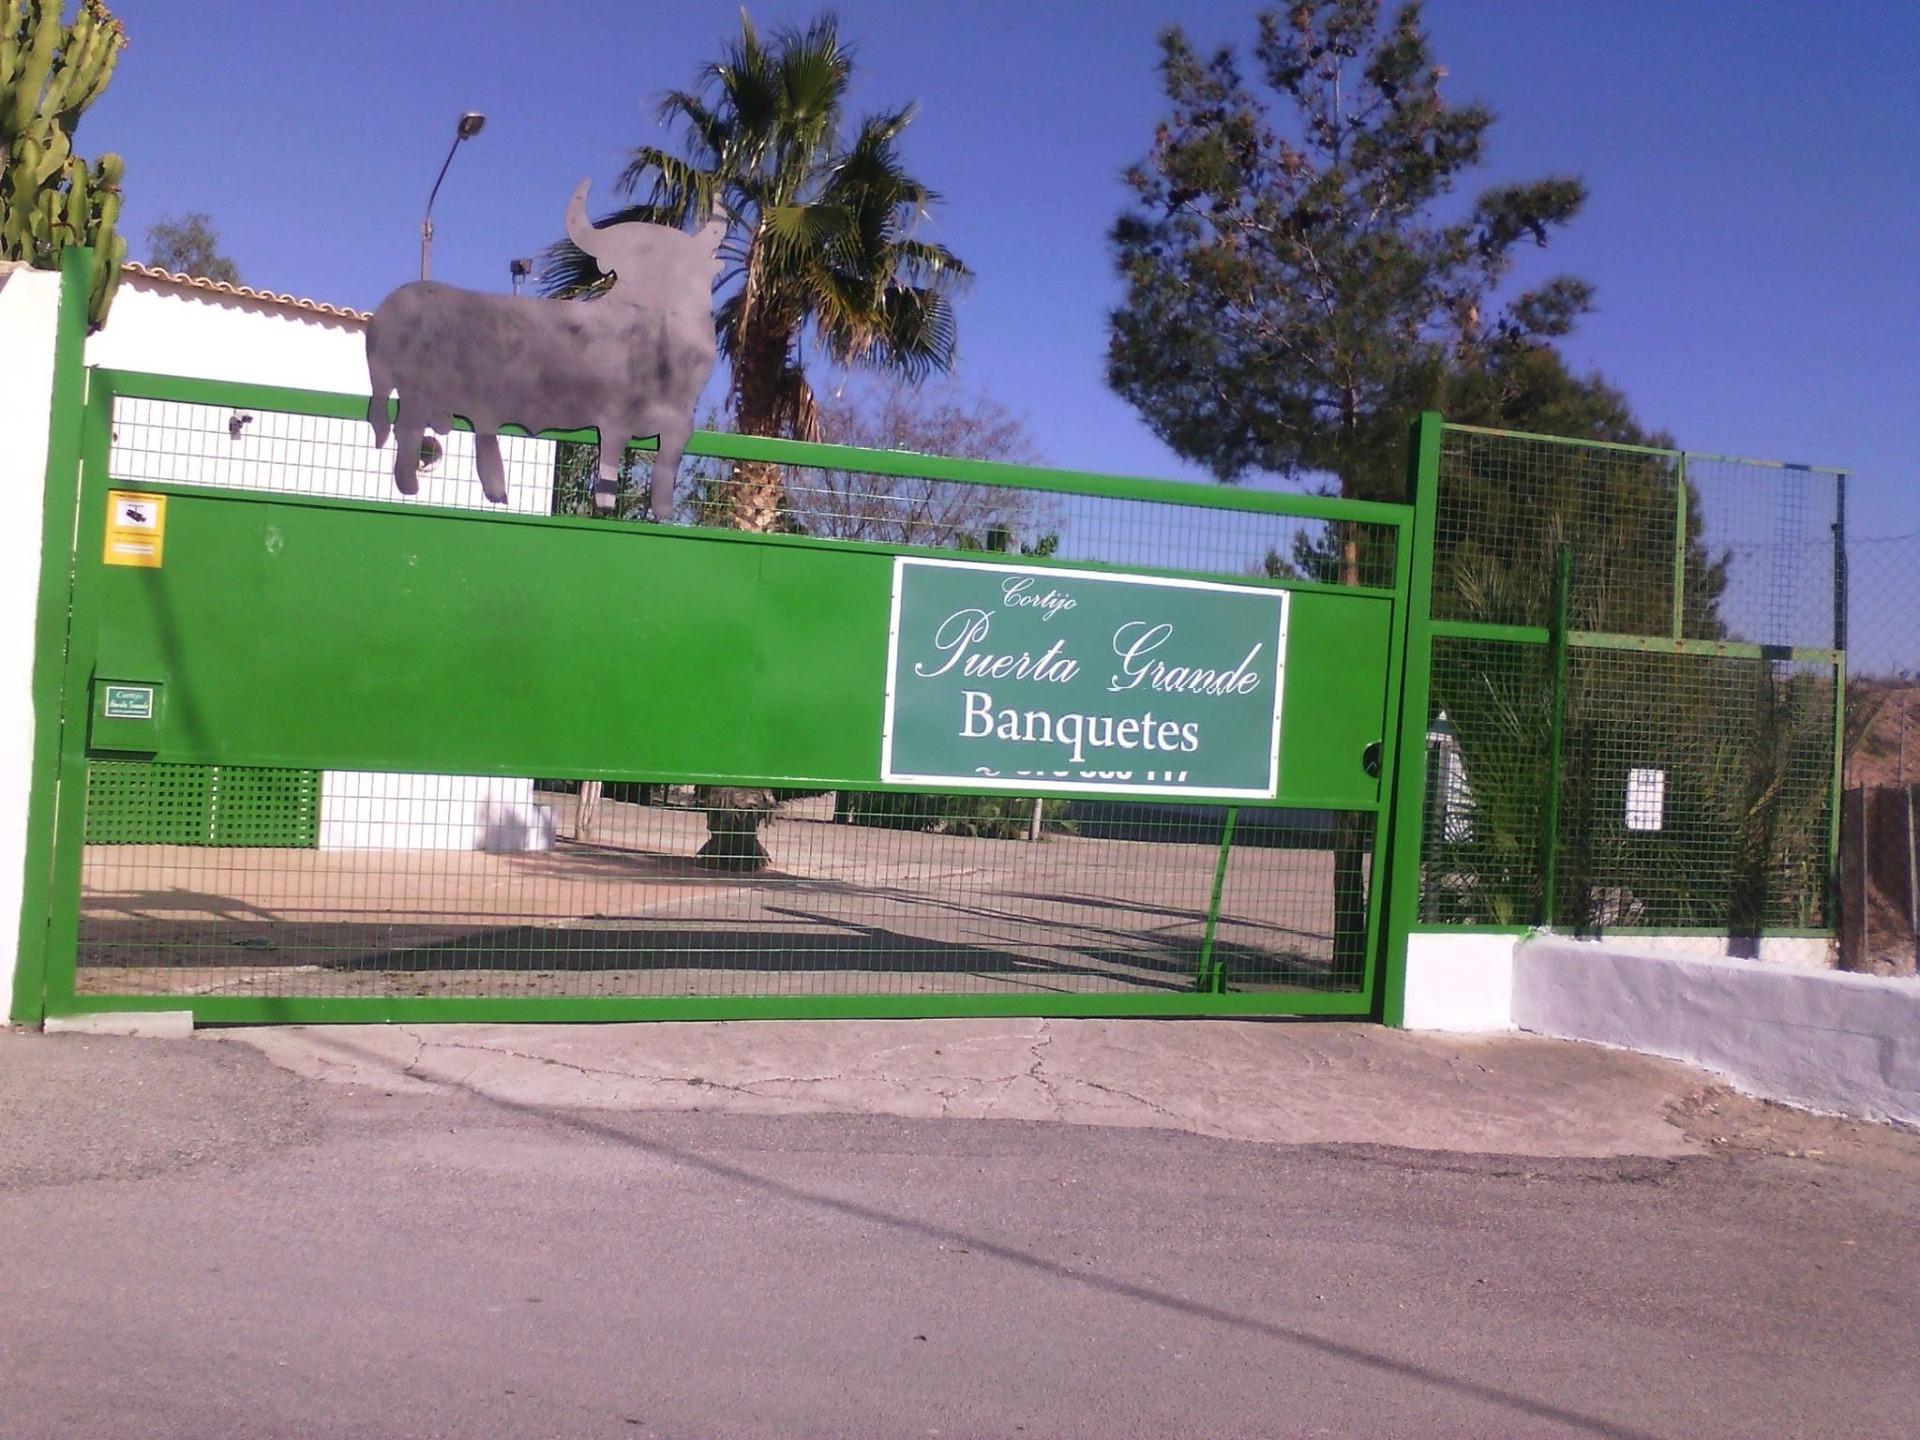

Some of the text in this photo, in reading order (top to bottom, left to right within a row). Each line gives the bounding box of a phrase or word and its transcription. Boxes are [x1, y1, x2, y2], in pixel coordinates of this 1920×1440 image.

[1001, 576, 1079, 621] Cortijo
[914, 608, 1263, 695] Puerta Grande
[959, 690, 1199, 763] Banquetes
